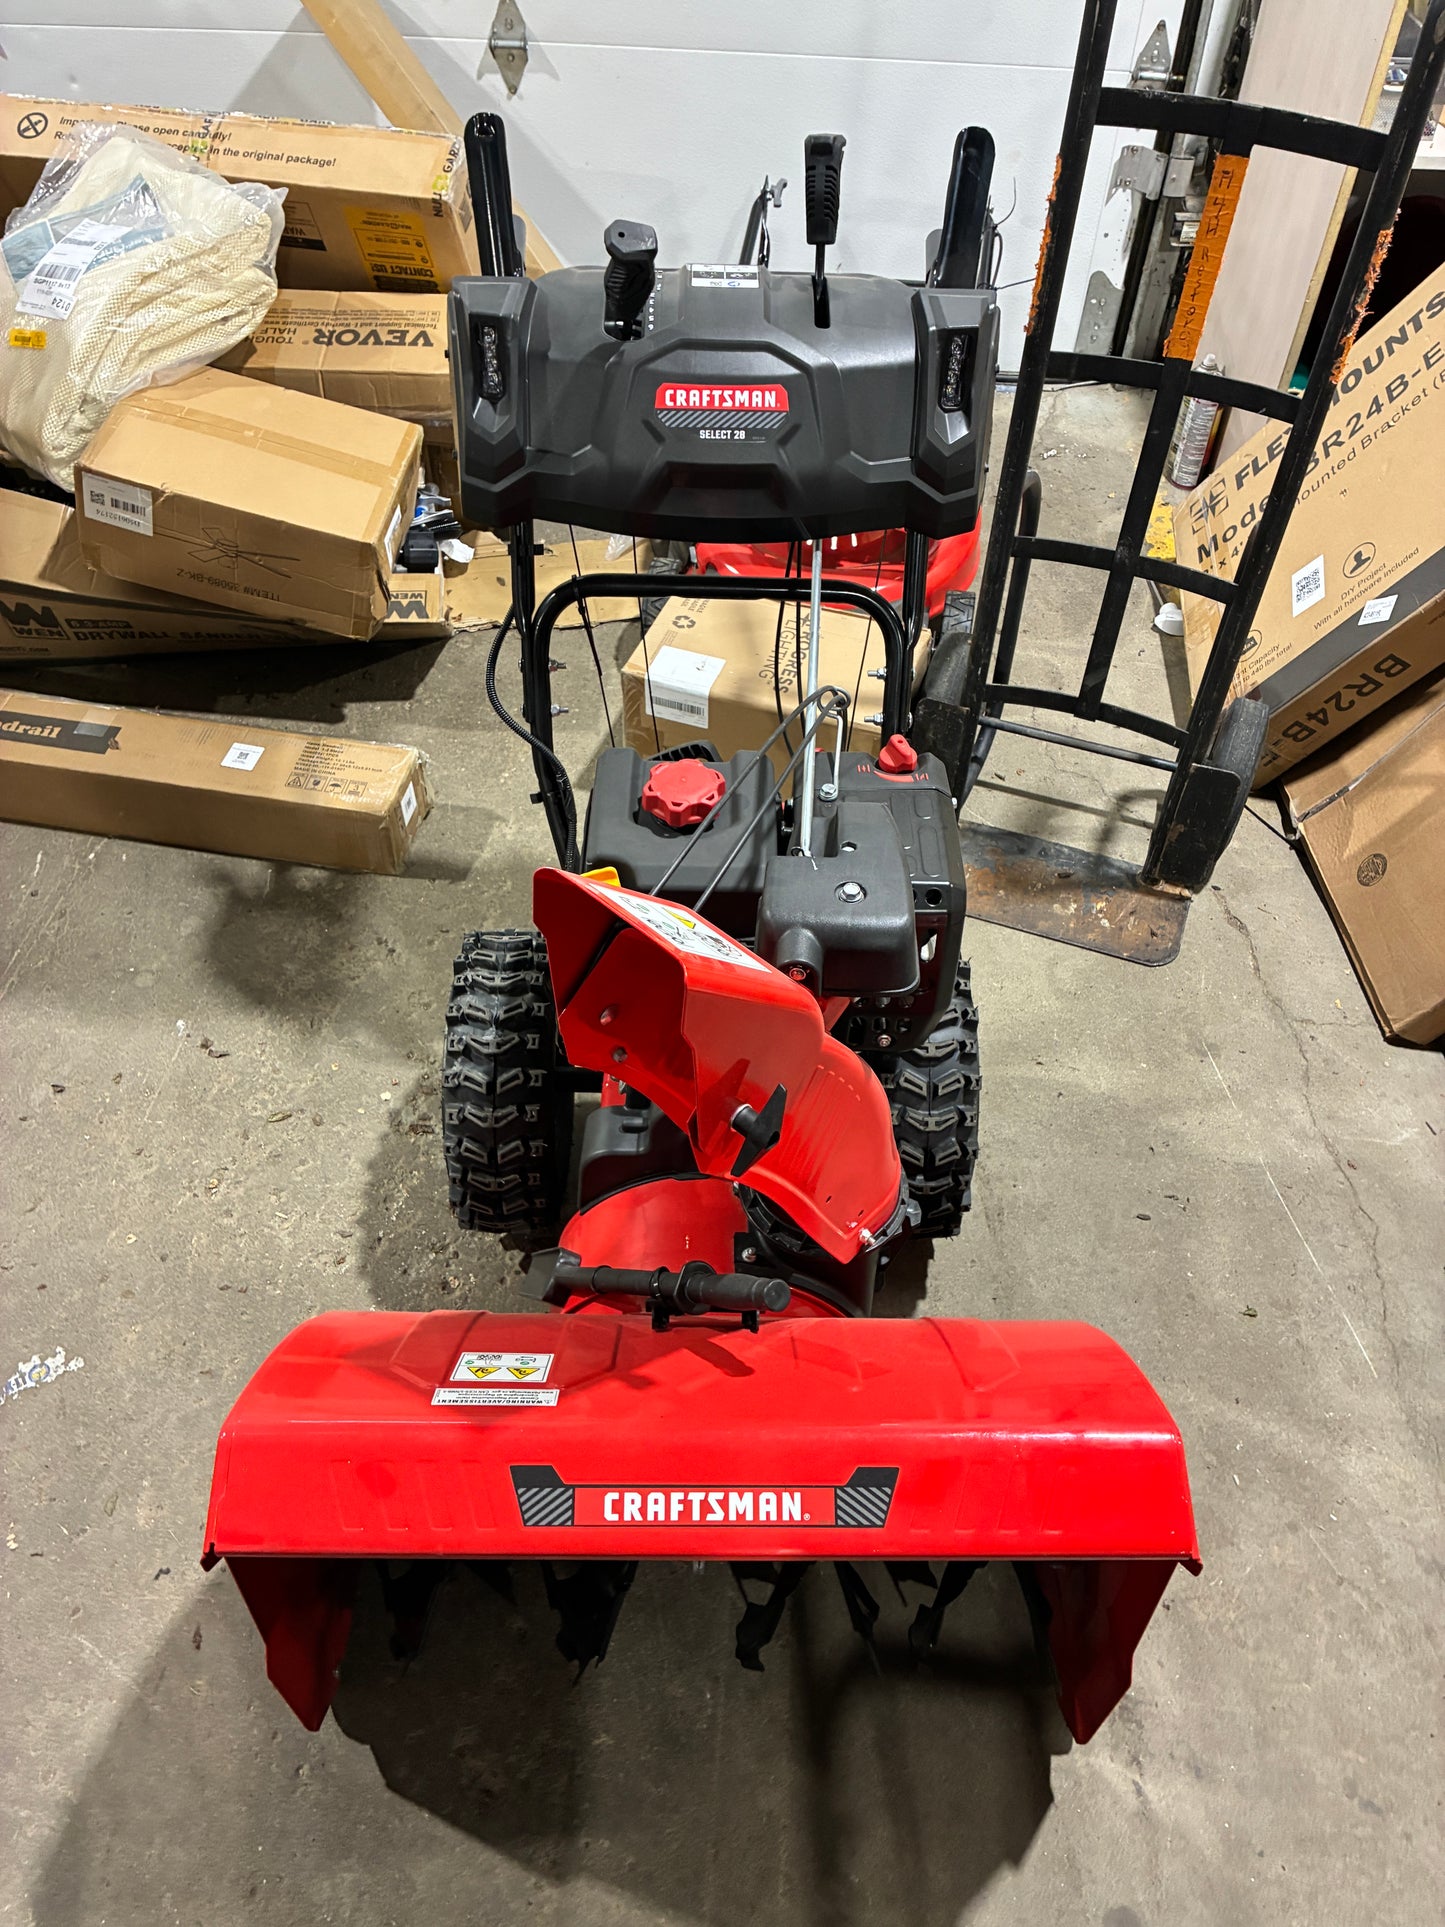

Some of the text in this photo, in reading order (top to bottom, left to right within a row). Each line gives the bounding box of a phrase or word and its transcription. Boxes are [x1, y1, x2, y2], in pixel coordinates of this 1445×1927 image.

[152, 125, 180, 136] open
[222, 148, 240, 158] the
[242, 150, 284, 162] original
[286, 154, 336, 167] package!
[390, 264, 434, 278] CONTACT
[260, 328, 296, 336] HALF
[313, 328, 434, 347] VEVOR
[665, 389, 776, 408] CRAFTSMAN
[1360, 387, 1428, 450] Bracket
[700, 430, 732, 440] SELECT
[733, 430, 746, 440] 28
[1314, 547, 1420, 630] With all hardware included
[1340, 562, 1386, 601] DIY Project
[13, 626, 64, 637] WEN
[74, 630, 171, 640] DRYWALL
[1248, 644, 1280, 670] Capacity
[1277, 642, 1292, 658] total
[604, 1492, 802, 1522] CRAFTSMAN
